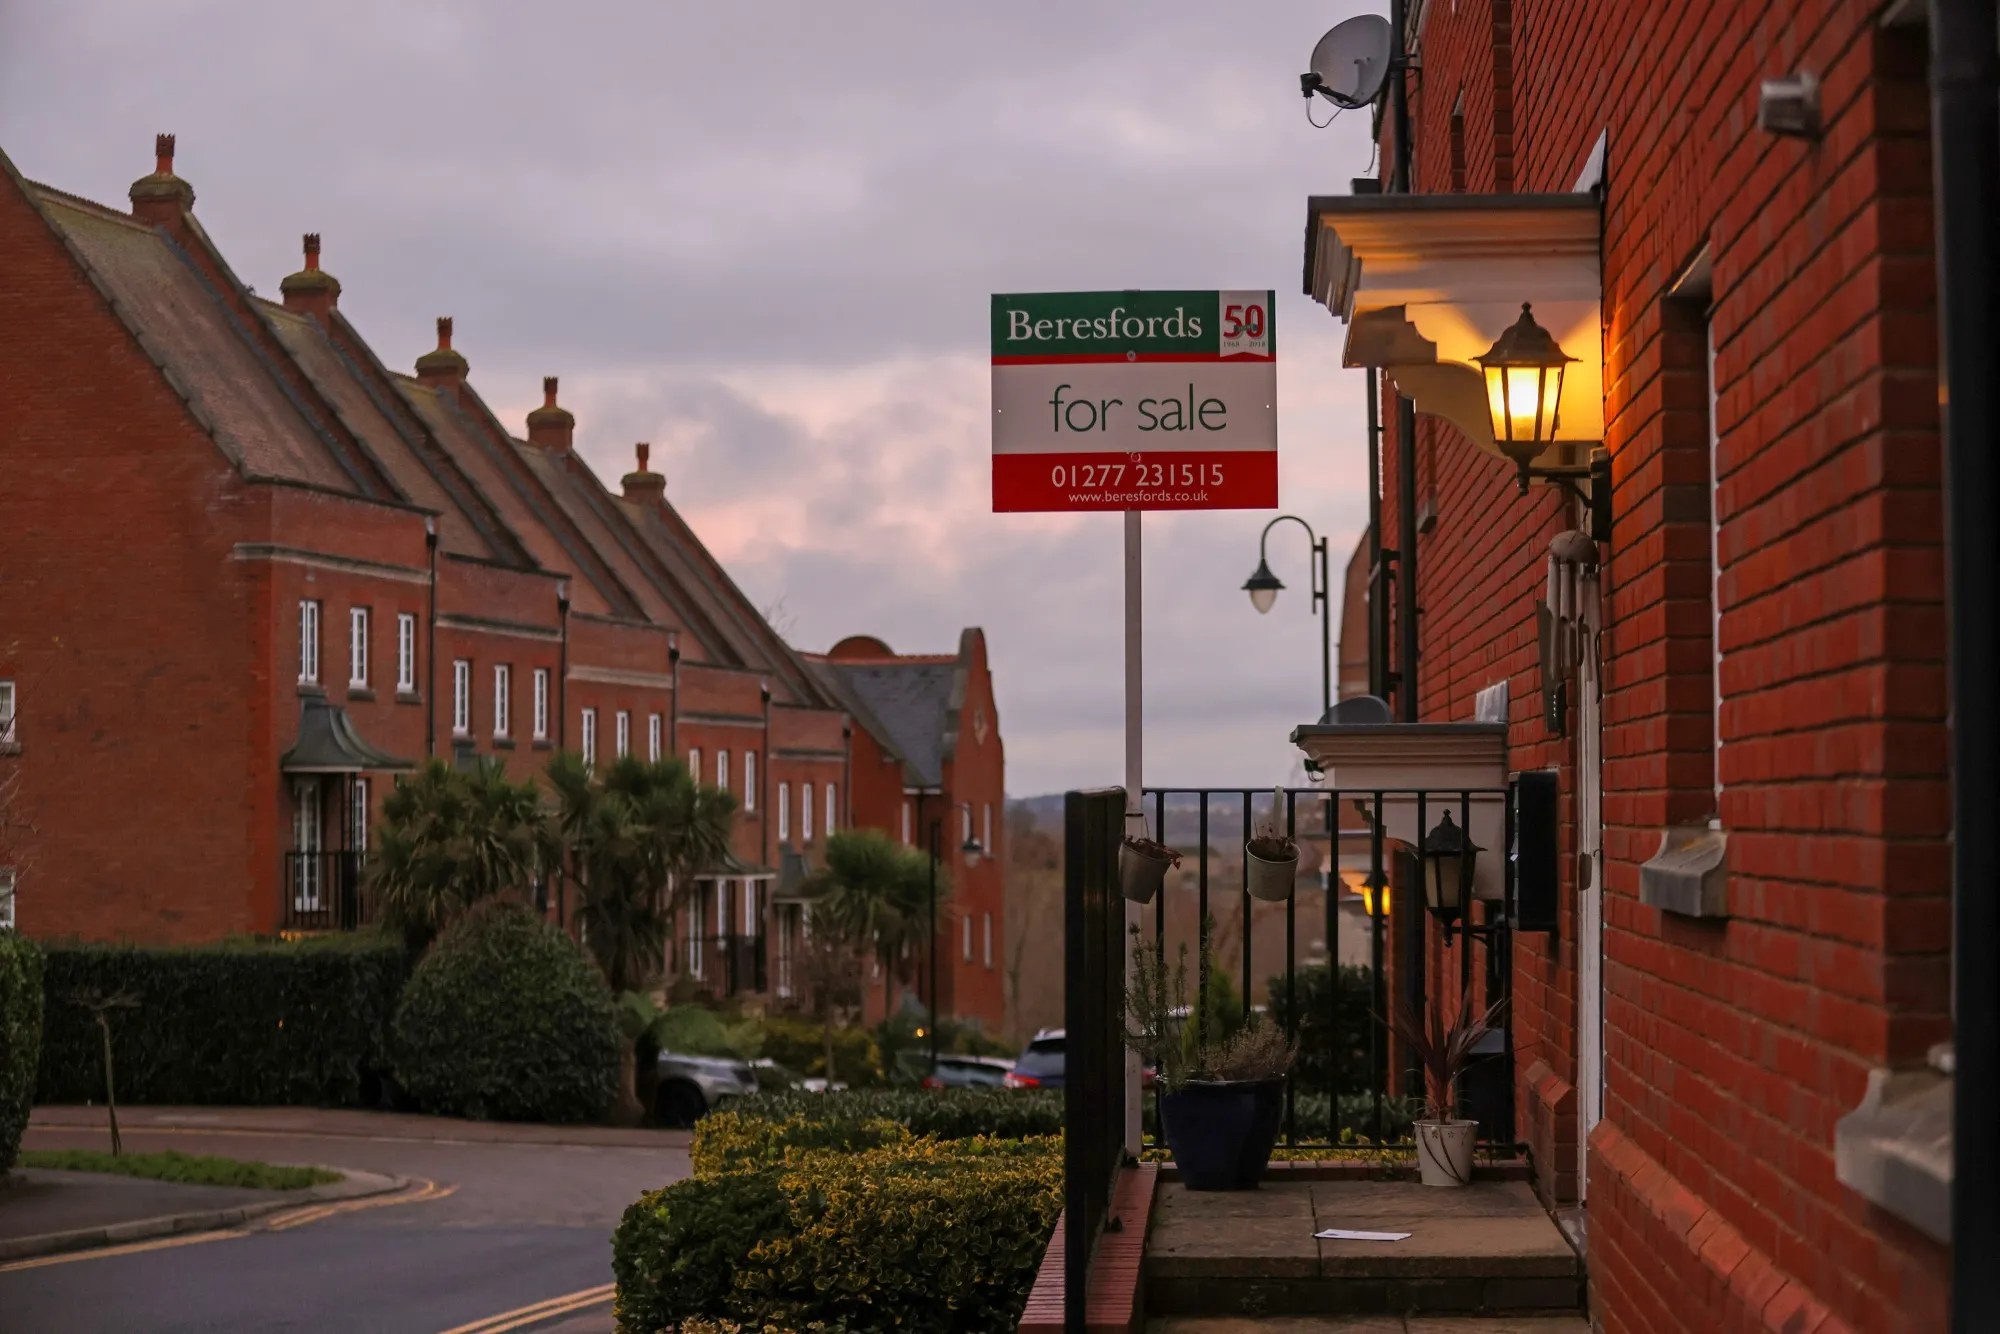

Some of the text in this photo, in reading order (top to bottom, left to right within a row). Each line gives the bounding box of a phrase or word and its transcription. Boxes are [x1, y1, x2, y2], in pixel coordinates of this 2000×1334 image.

[1006, 307, 1203, 341] Beresfords
[1223, 304, 1265, 338] 50
[1048, 383, 1227, 432] for sale
[1051, 463, 1224, 488] 01277 231515
[1068, 489, 1209, 502] www.beresfords.co.uk
